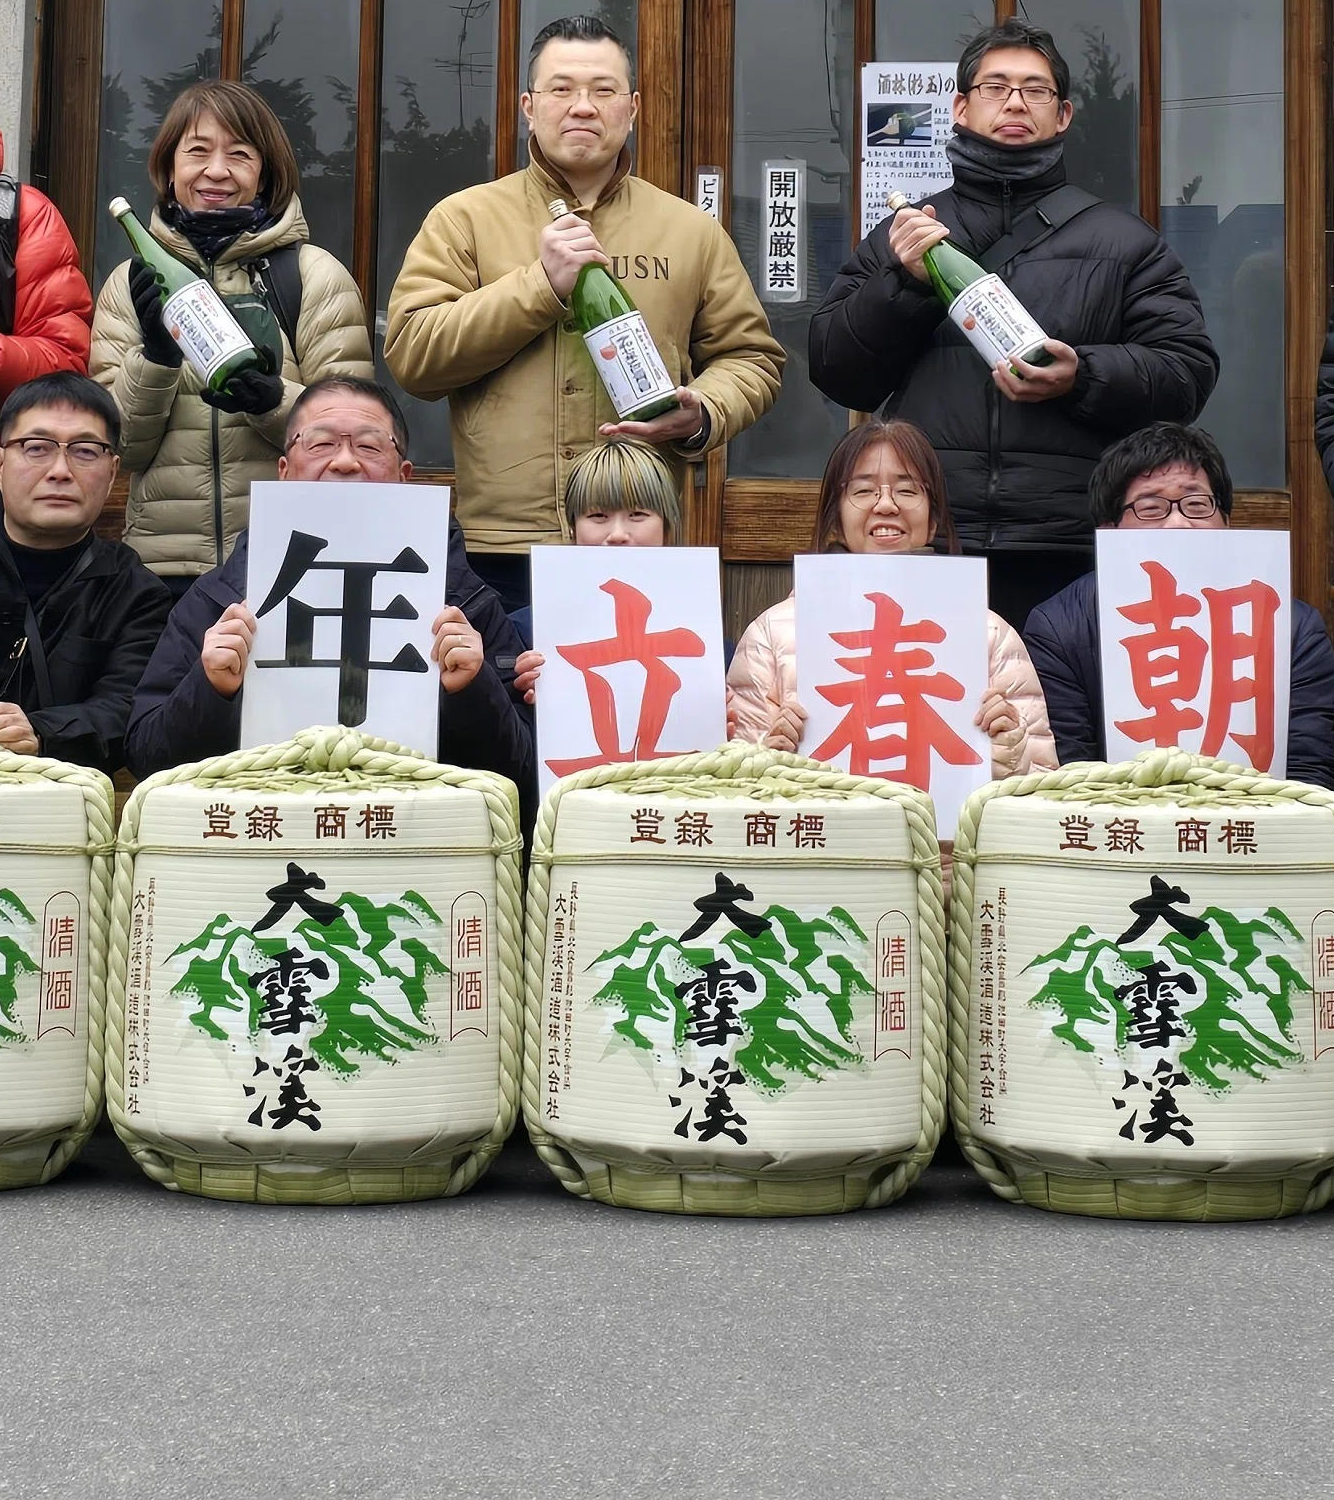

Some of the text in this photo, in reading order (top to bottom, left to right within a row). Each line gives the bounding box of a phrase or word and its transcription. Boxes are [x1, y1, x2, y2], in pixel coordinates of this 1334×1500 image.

[611, 255, 670, 281] USN
[701, 178, 717, 218] ピタ
[769, 170, 796, 288] 開放厳禁
[255, 530, 430, 726] 年
[545, 578, 706, 777] 立
[809, 592, 983, 794] 春
[1114, 561, 1281, 775] 朝
[46, 915, 75, 1011] 清酒
[243, 862, 344, 1131] 大雪渓
[456, 916, 483, 1012] 清酒
[669, 871, 773, 1145] 大雪渓
[881, 937, 906, 1033] 清酒
[1112, 874, 1209, 1147] 大雪渓
